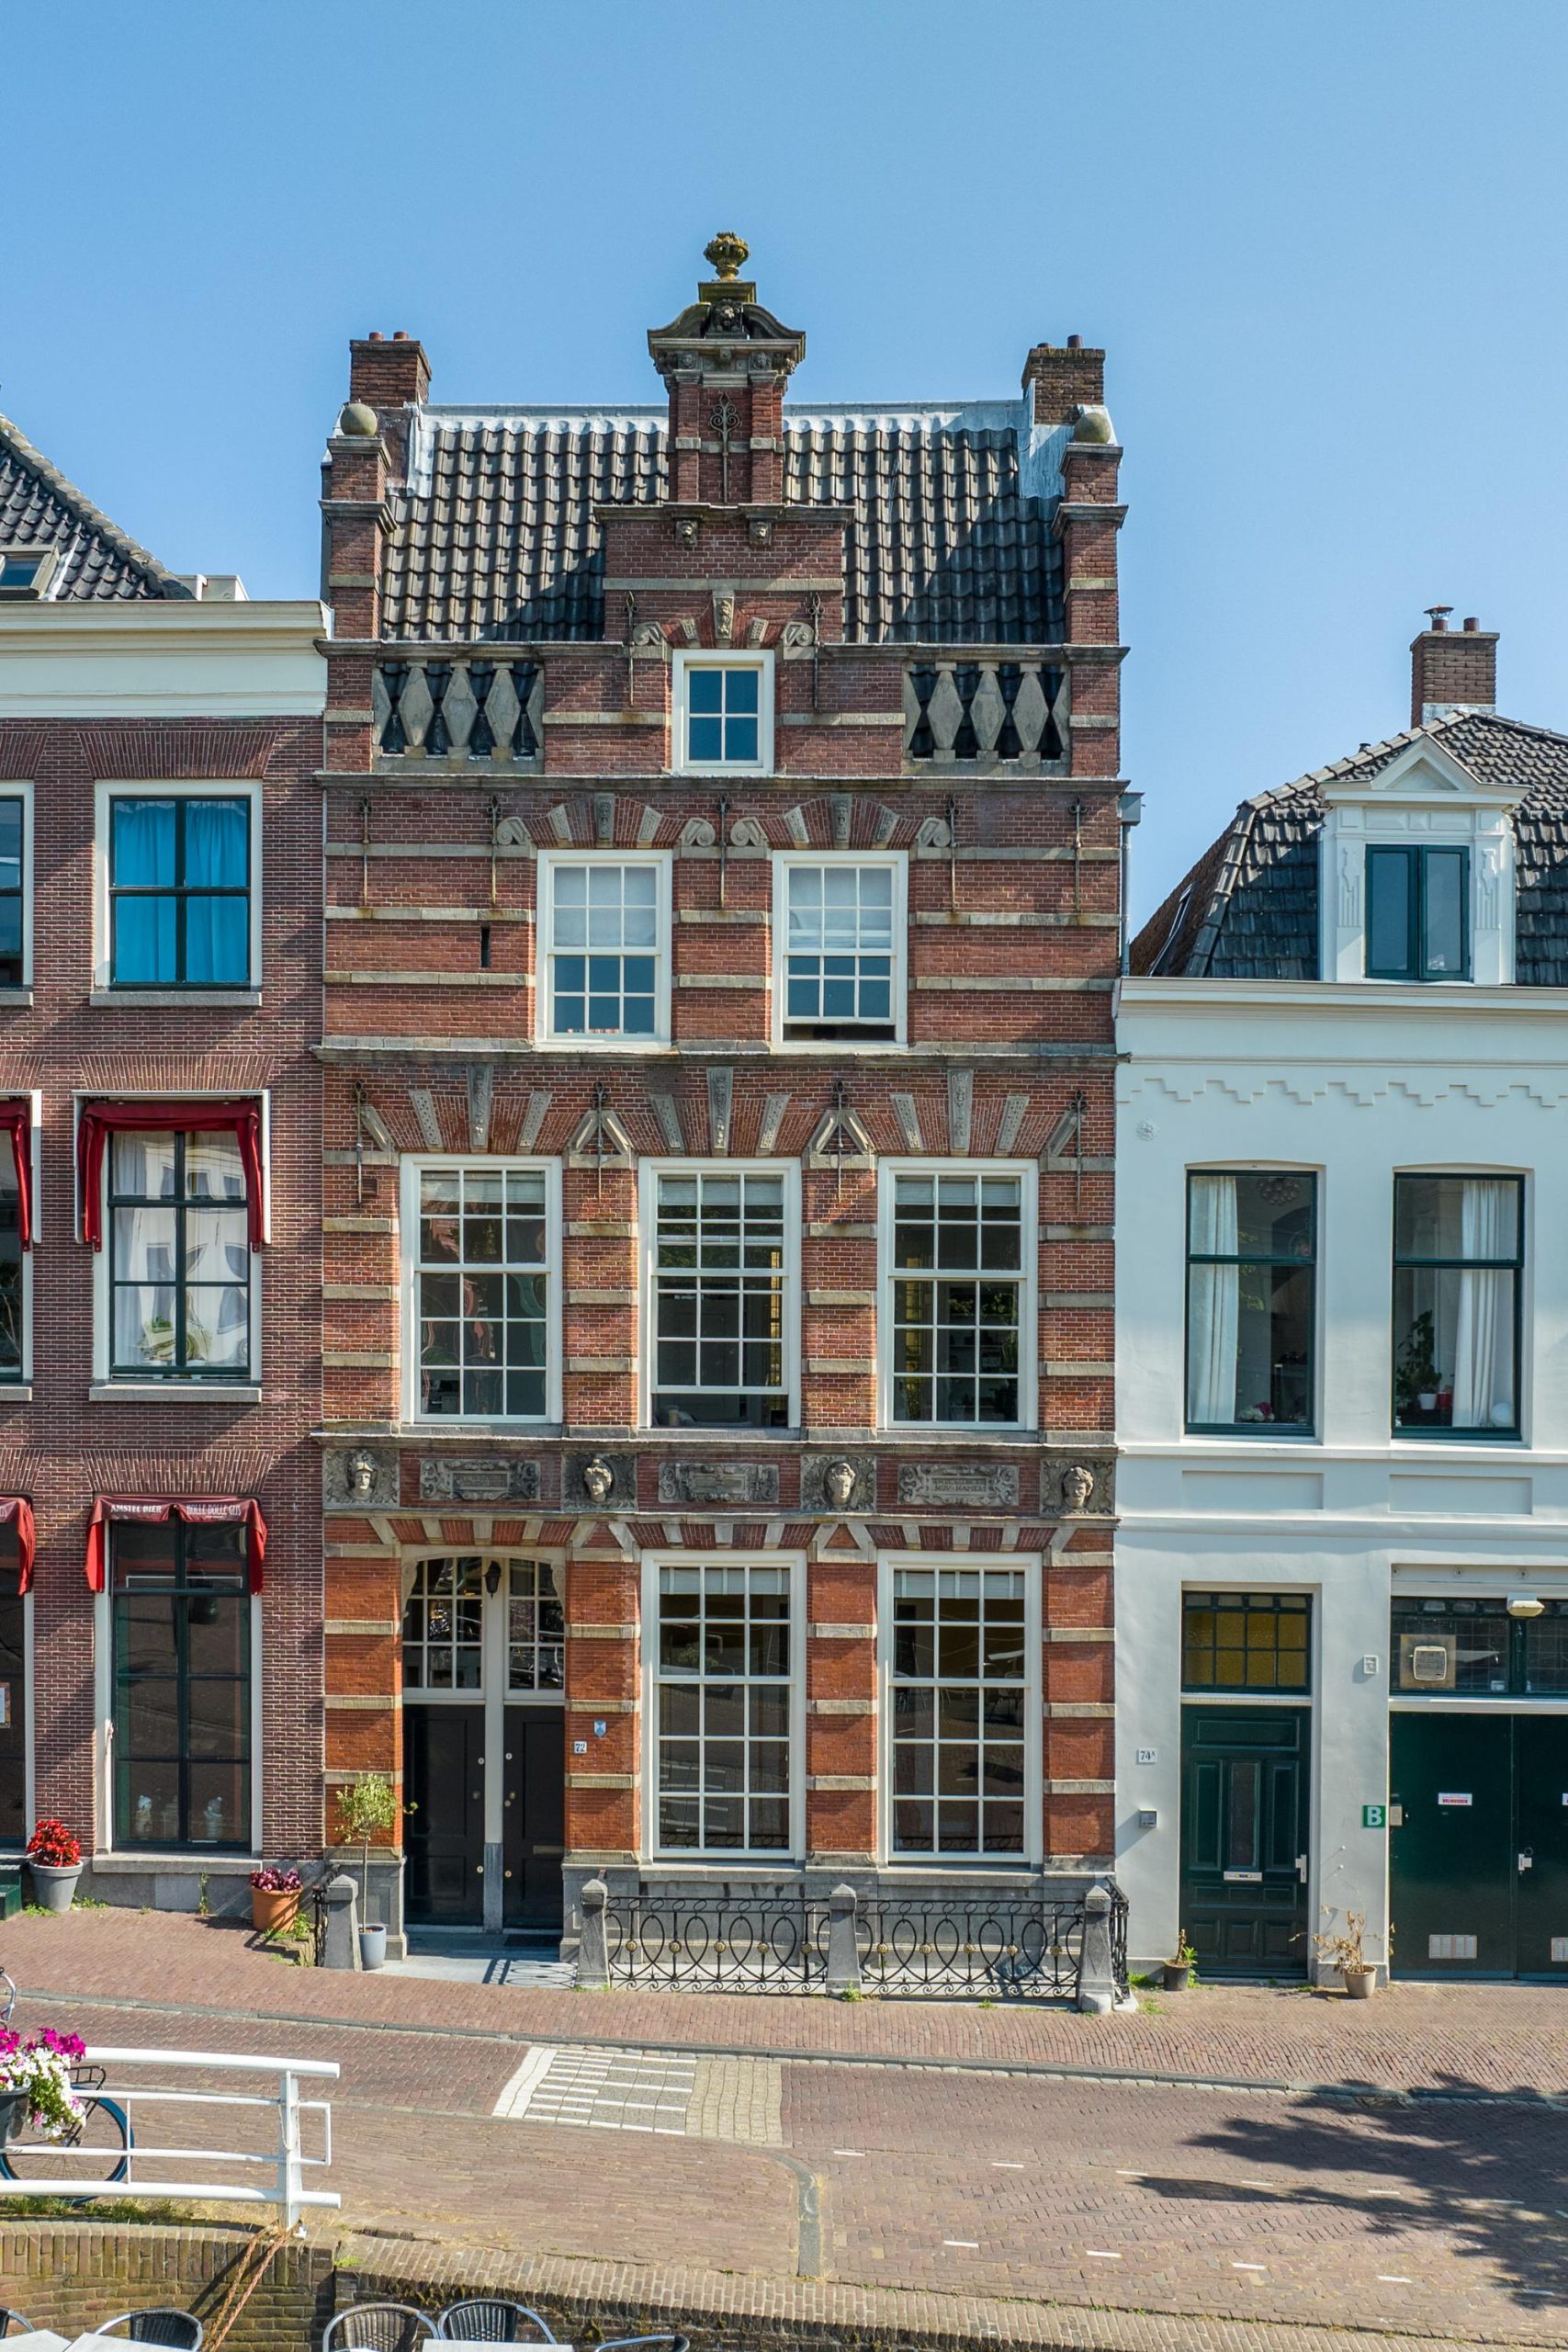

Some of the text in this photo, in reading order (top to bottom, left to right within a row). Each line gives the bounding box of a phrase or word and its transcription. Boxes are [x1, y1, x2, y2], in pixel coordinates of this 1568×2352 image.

[111, 1504, 163, 1513] AMSTEL BIER
[575, 1743, 585, 1752] 72
[1367, 1806, 1382, 1826] B
